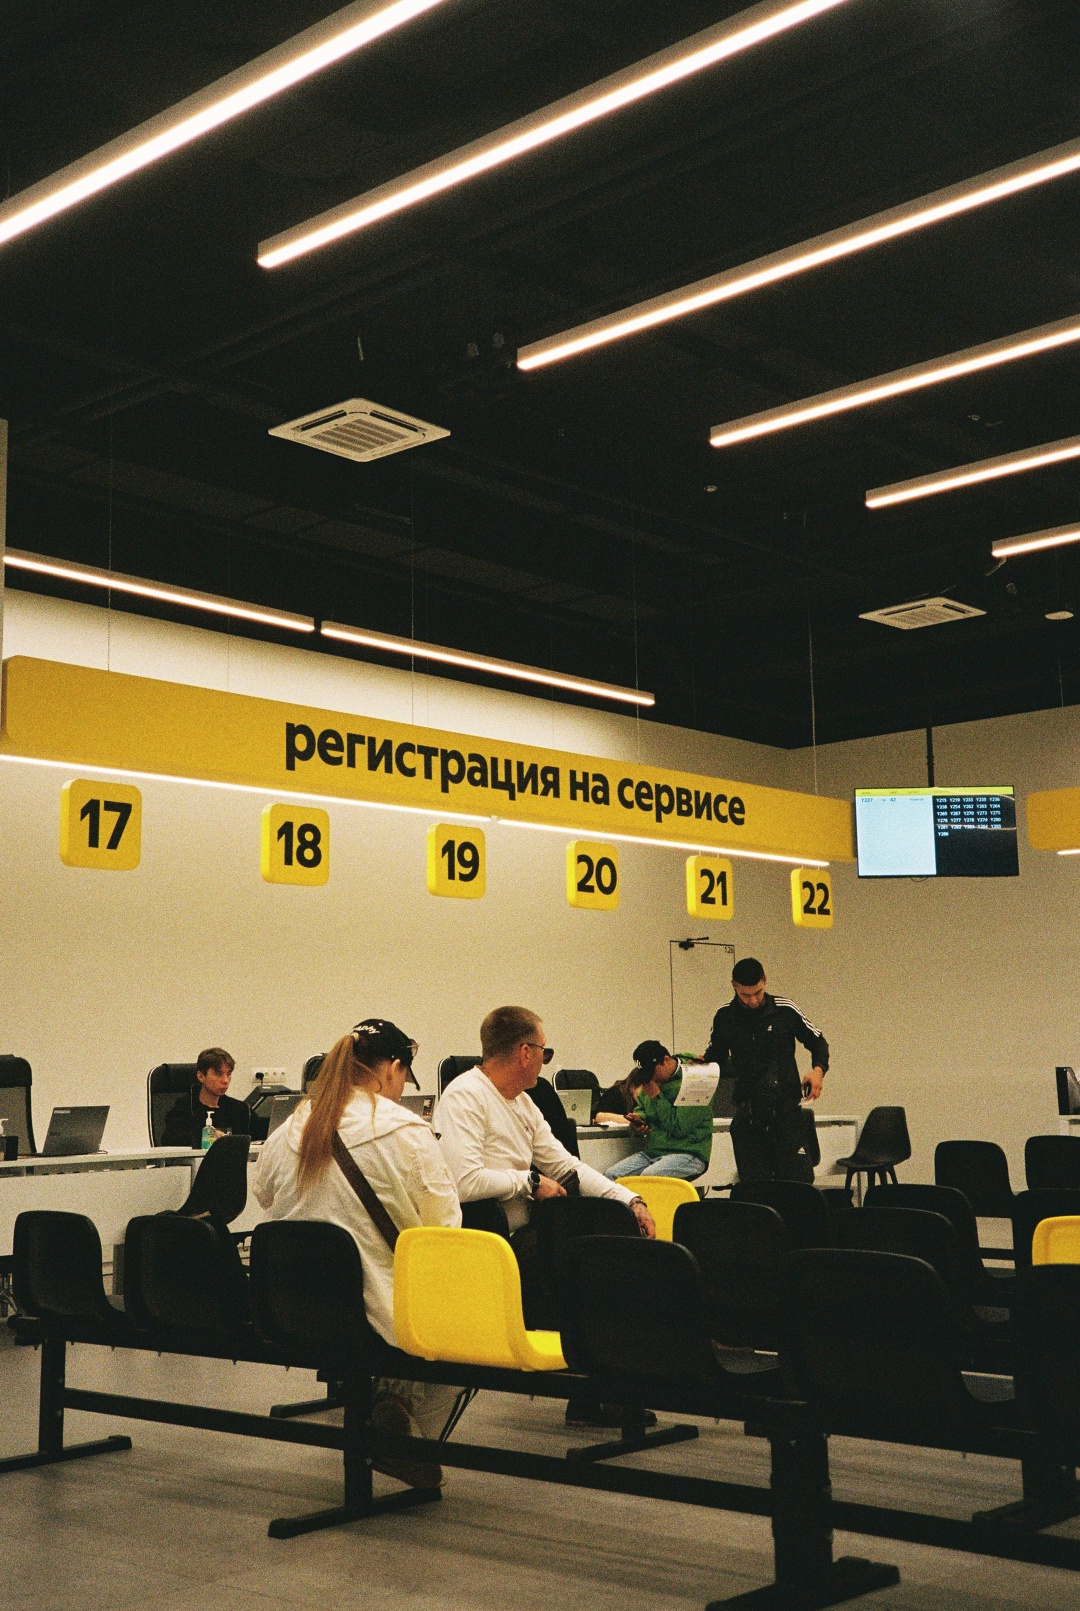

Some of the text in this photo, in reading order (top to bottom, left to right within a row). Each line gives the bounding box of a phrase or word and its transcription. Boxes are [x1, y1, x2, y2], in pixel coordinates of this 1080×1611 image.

[286, 723, 745, 825] регистрация на сервисе
[81, 799, 131, 849] 17
[278, 822, 321, 867] 18
[442, 840, 479, 881] 19
[578, 855, 616, 894] 20
[701, 869, 726, 905] 21
[803, 882, 830, 915] 22
